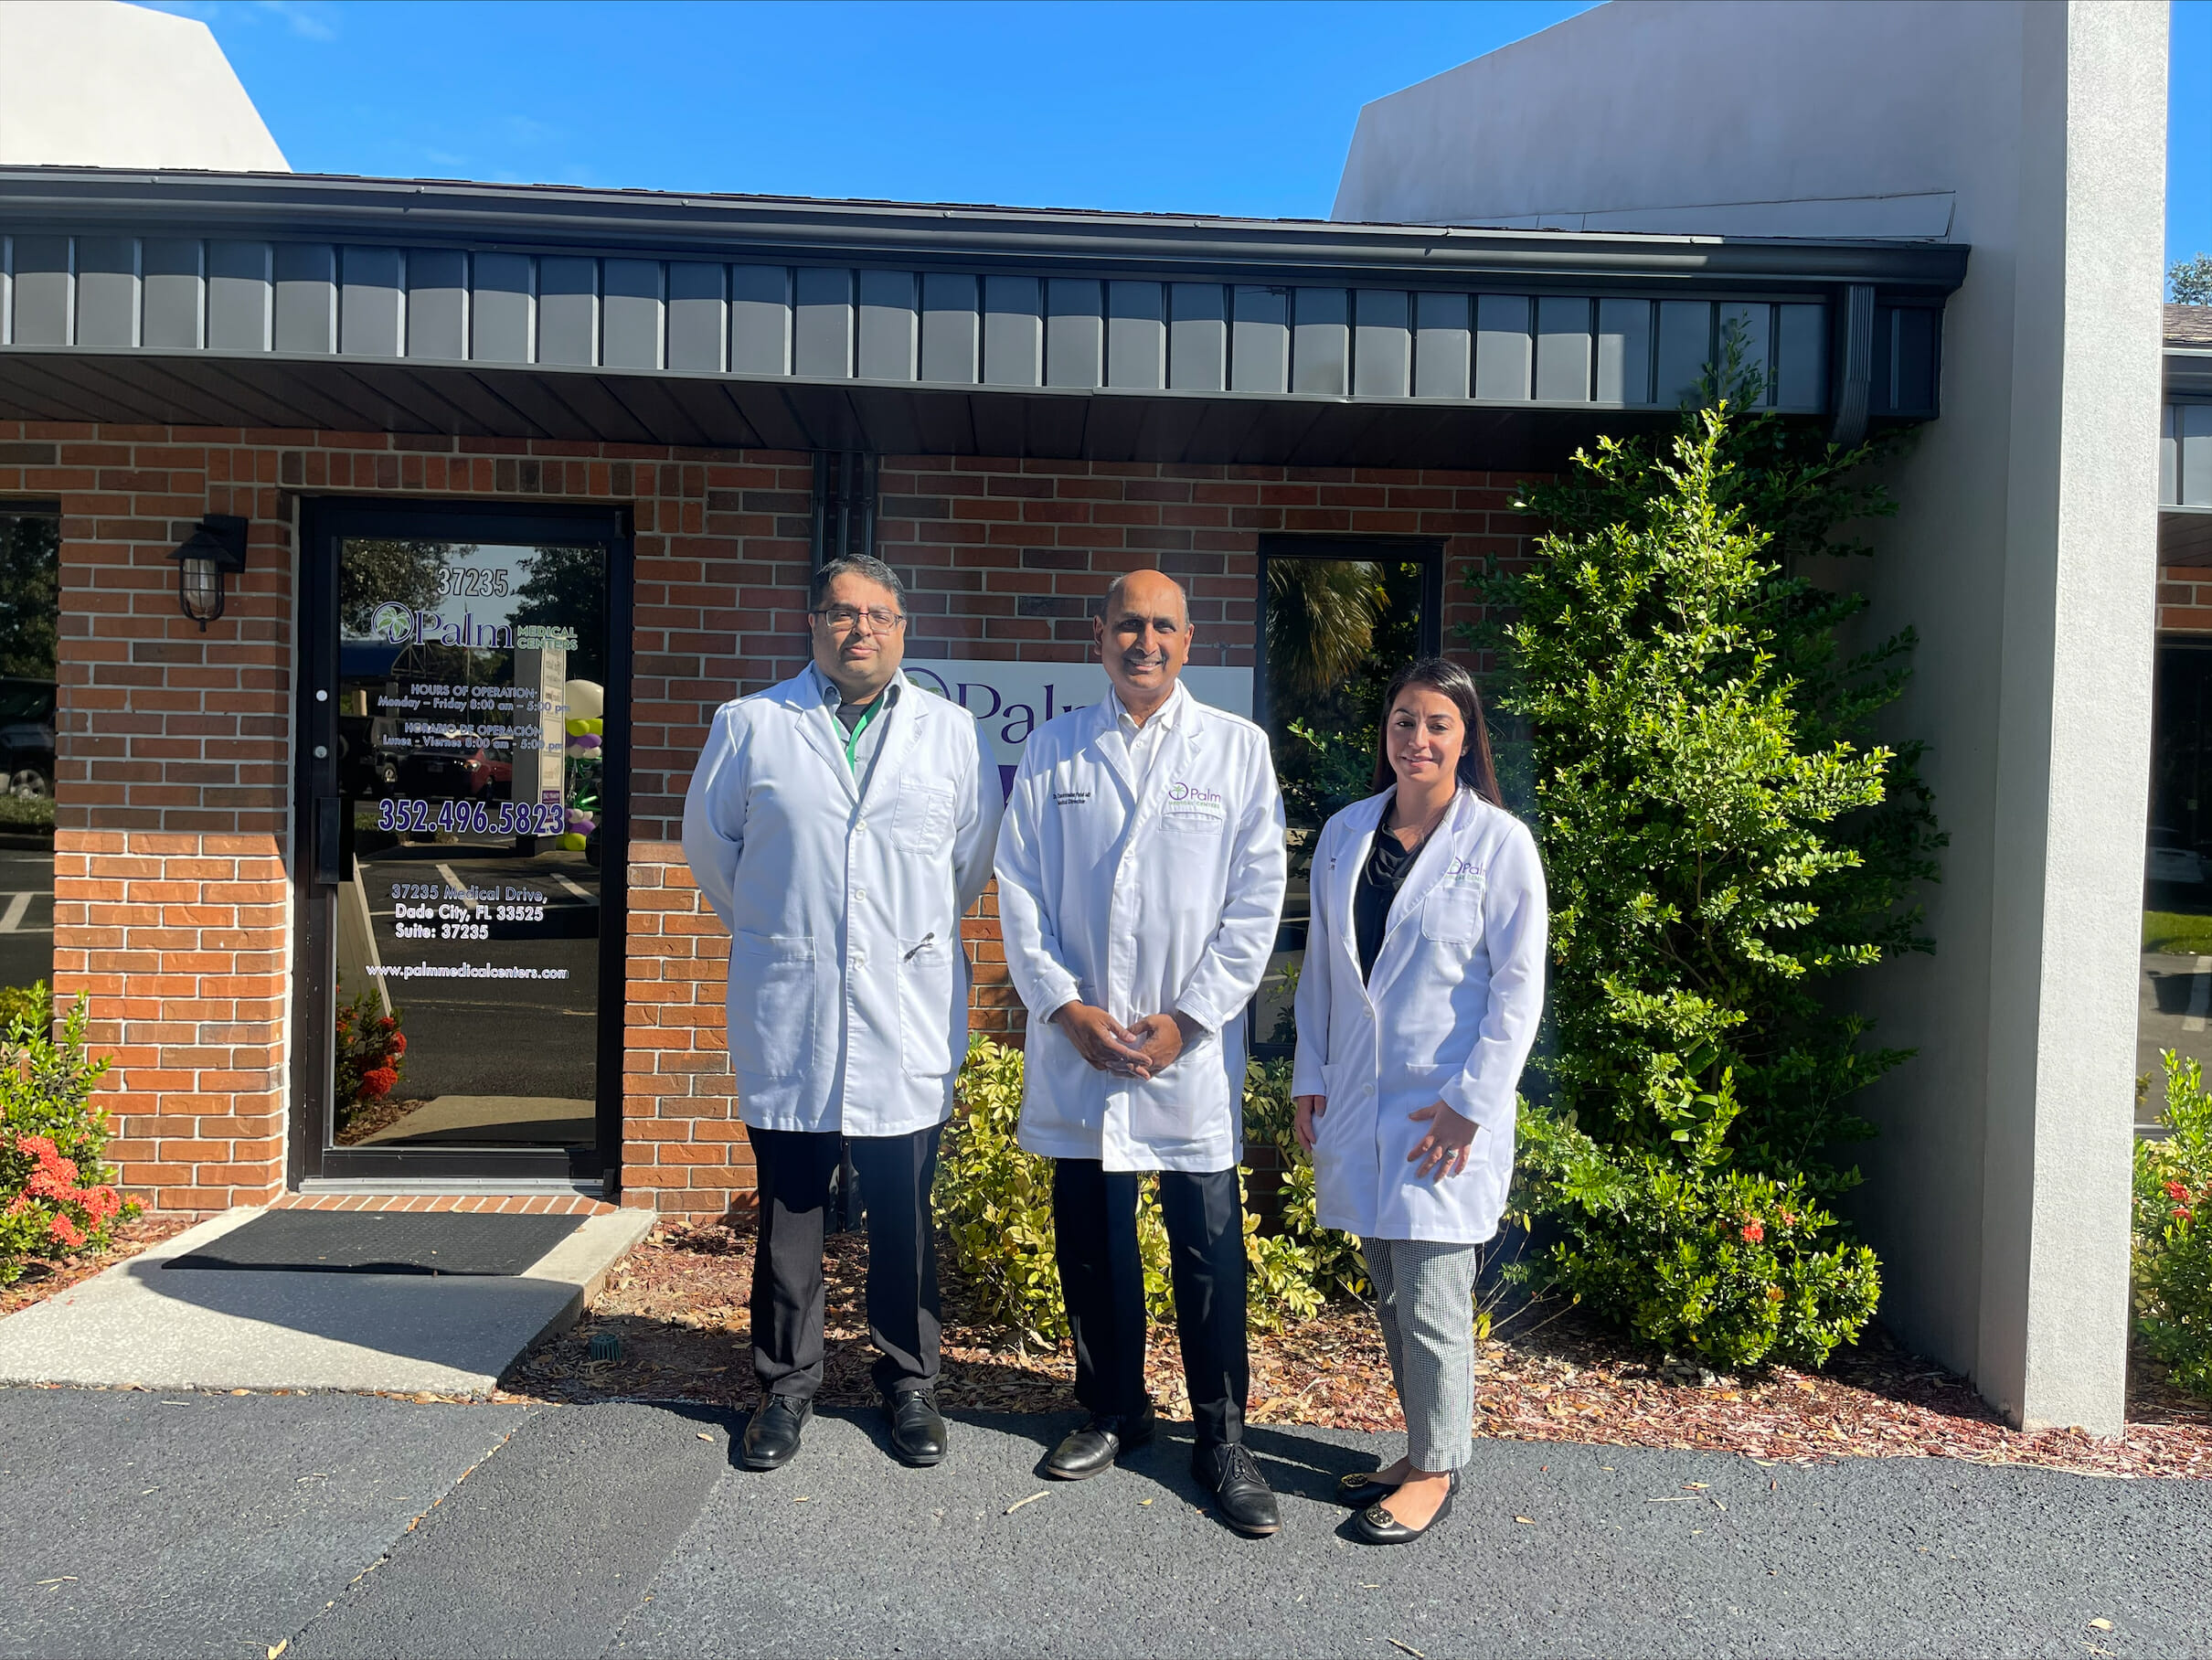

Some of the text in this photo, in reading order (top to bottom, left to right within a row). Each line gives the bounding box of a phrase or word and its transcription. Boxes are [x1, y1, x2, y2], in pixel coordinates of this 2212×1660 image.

[437, 568, 508, 597] 37235
[414, 610, 514, 648] Palm
[517, 625, 578, 638] MEDICAL
[517, 638, 579, 651] CENTERS
[410, 684, 450, 696] HOURS
[452, 686, 469, 697] OF
[378, 695, 420, 710] Monday
[432, 697, 467, 712] Friday
[470, 698, 495, 710] 8:00
[526, 700, 551, 711] 5:00
[555, 704, 570, 714] pm
[956, 683, 1093, 744] Pal
[404, 722, 457, 734] HORARIO
[459, 724, 474, 734] DE
[382, 734, 412, 746] Lunes
[422, 736, 462, 747] Viernes
[464, 738, 490, 749] 8:00
[493, 740, 509, 749] am
[520, 739, 545, 750] 5:00
[1190, 788, 1221, 803] Palm
[378, 798, 565, 835] 352.496.5823
[391, 884, 548, 904] 37235 Medical Drive,
[395, 903, 544, 922] Dade City, FL 33525
[395, 922, 489, 940] Suite: 37235
[366, 962, 569, 980] www.palmmedicalcenters.com
